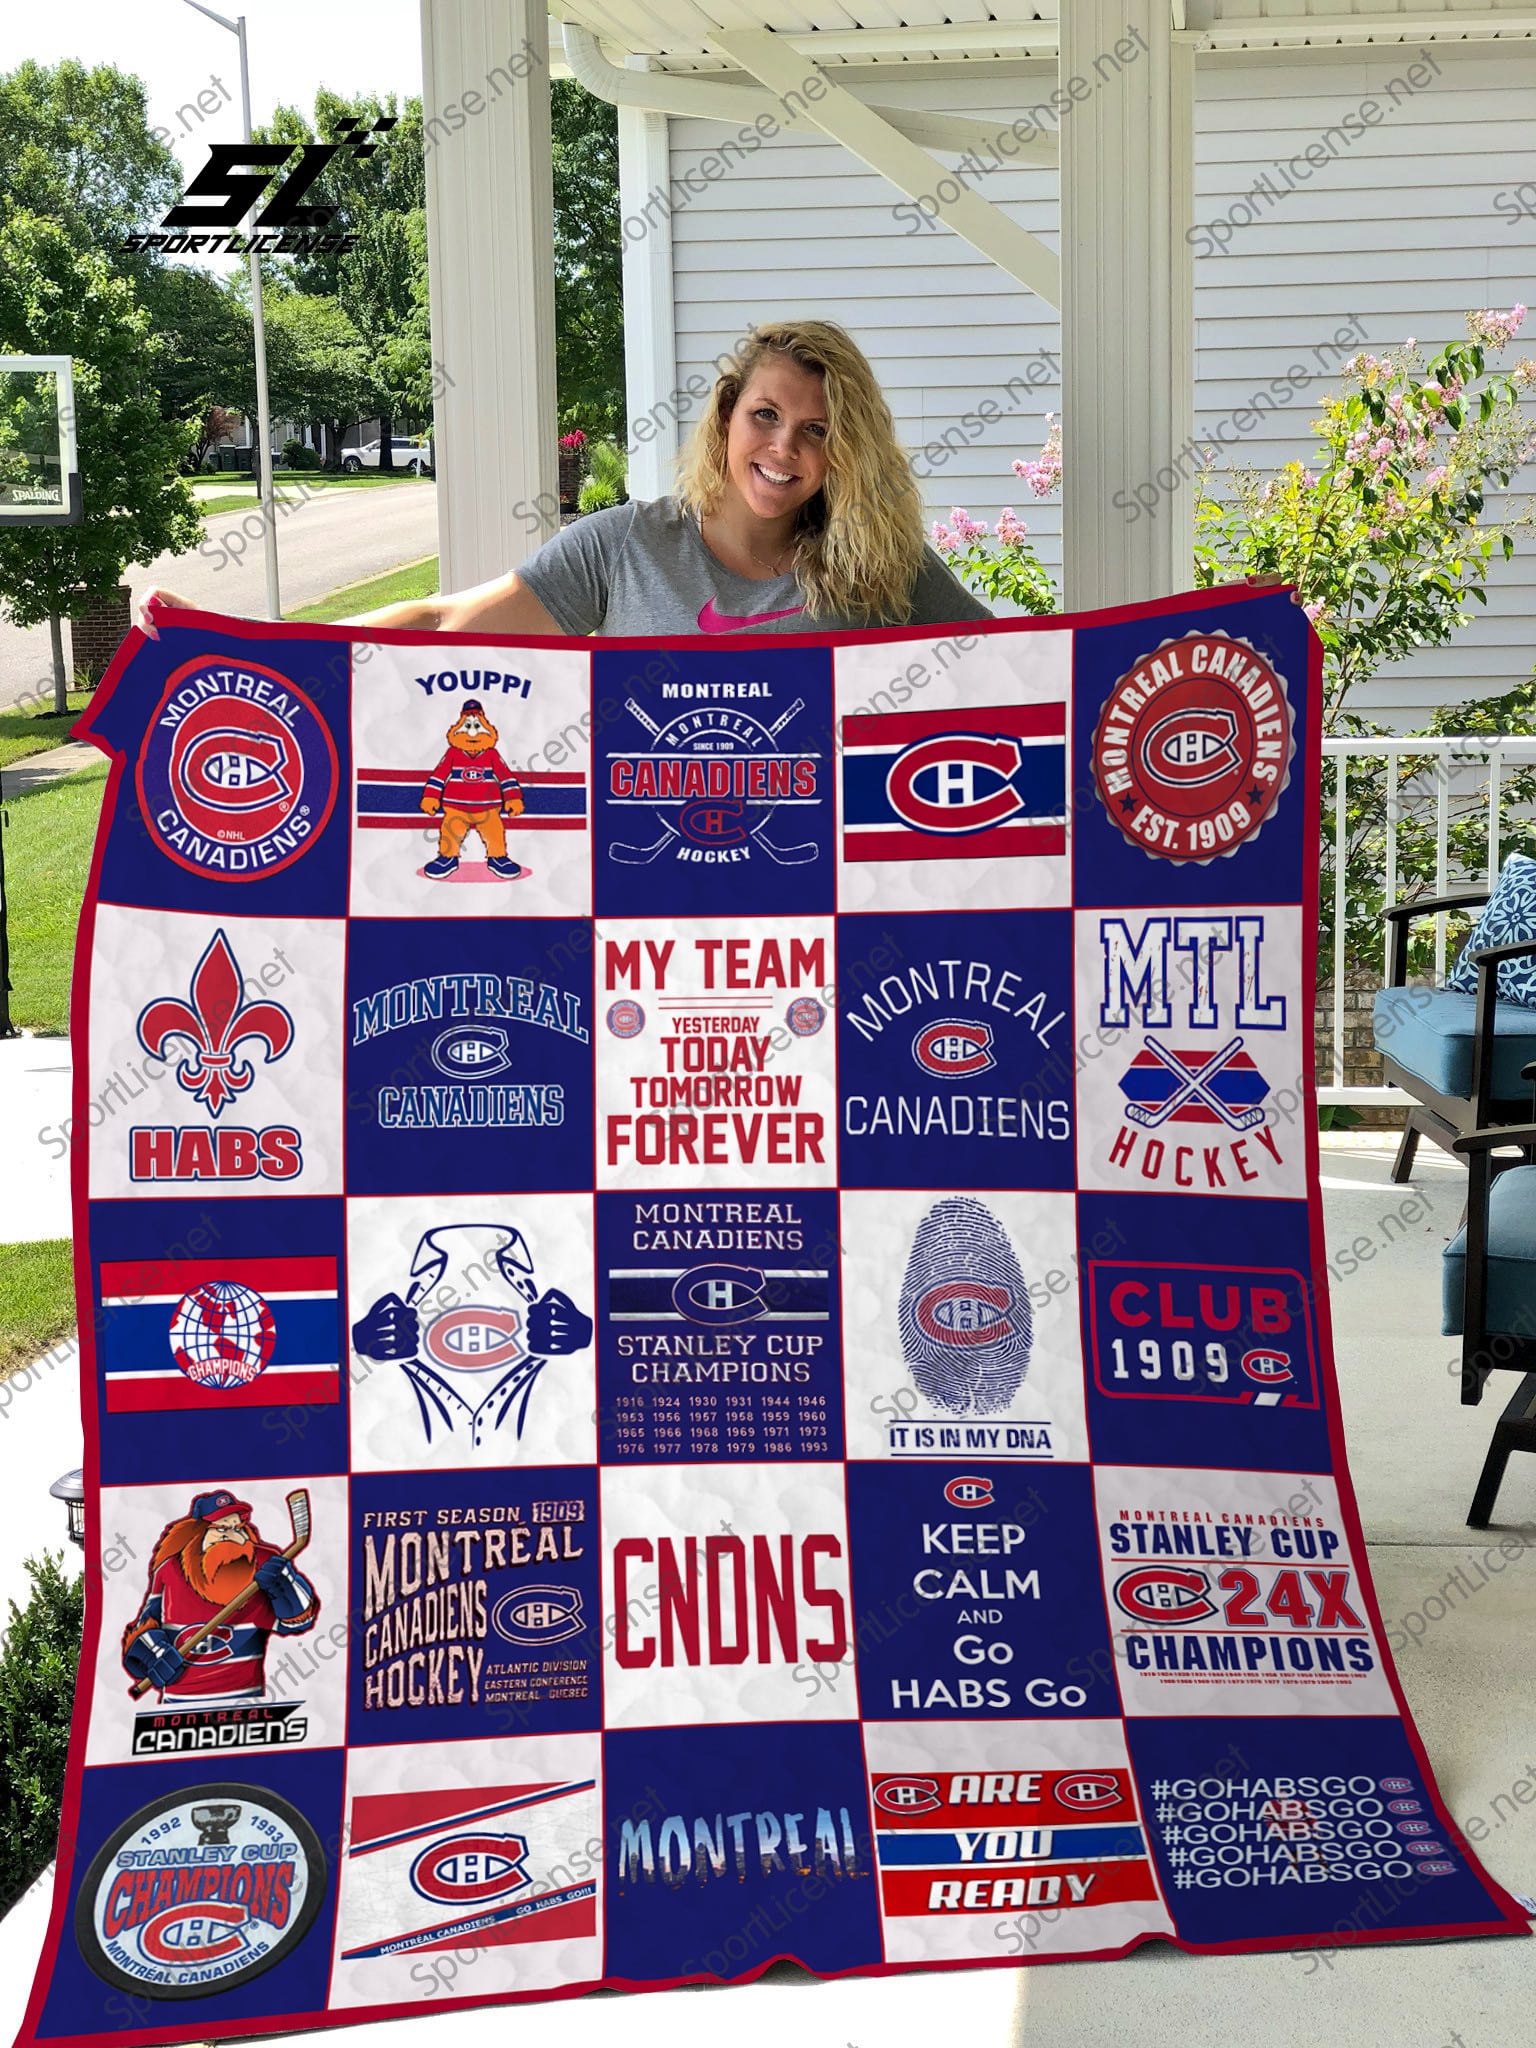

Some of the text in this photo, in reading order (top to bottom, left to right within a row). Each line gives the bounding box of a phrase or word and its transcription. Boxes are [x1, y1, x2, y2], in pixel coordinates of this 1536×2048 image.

[12, 489, 61, 502] SPALDING
[159, 671, 300, 728] MONTREAL
[415, 670, 532, 699] YOUPPI
[662, 682, 772, 698] MONTREAL
[666, 713, 763, 747] MONTREAL
[1102, 644, 1283, 796] MONTREAL CANADIENS
[693, 742, 734, 751] SINCE 1909
[610, 760, 817, 797] CANADIENS
[1130, 801, 1251, 851] EST. 1909
[676, 847, 750, 863] HOCKEY
[605, 938, 825, 990] MY TEAM
[1100, 915, 1286, 1031] MTL
[353, 973, 589, 1047] MONTREAL
[846, 960, 1066, 1050] MONTREAL
[672, 1016, 760, 1033] YESTERDAY
[660, 1036, 771, 1073] TODAY
[378, 1084, 564, 1129] CANADIENS
[630, 1075, 802, 1108] TOMORROW
[846, 1096, 1070, 1140] CANADIENS
[129, 1125, 303, 1182] HABS
[607, 1113, 825, 1166] FOREVER
[1108, 1125, 1283, 1188] HOCKEY
[635, 1203, 802, 1224] MONTREAL
[633, 1230, 803, 1251] CANADIENS
[1110, 1280, 1291, 1334] CLUB
[618, 1335, 823, 1356] STANLEY CUP
[1112, 1338, 1229, 1383] 1909
[188, 1358, 258, 1383] CHAMPIONS
[632, 1362, 811, 1383] CHAMPIONS
[616, 1396, 826, 1408] 1916 1924 1930 1931 1944 1946
[653, 1411, 680, 1422] 1956
[762, 1411, 790, 1421] 1959
[798, 1411, 826, 1421] 1960
[617, 1426, 827, 1438] 1965 1966 1968 1969 1971 1973
[889, 1428, 1052, 1449] IT IS IN MY DNA
[617, 1442, 828, 1454] 1976 1977 1978 1979 1986 1993
[363, 1501, 583, 1529] FIRST SEASON 1909
[1119, 1510, 1325, 1528] MONTREAL CANADIENS
[922, 1523, 1026, 1554] KEEP
[1109, 1523, 1339, 1560] STANLEY CUP
[913, 1569, 1041, 1600] CALM
[1217, 1568, 1365, 1629] 24X
[613, 1534, 848, 1669] CNDNS
[957, 1609, 1003, 1624] AND
[365, 1579, 488, 1671] CANADIENS
[486, 1660, 587, 1675] ATLANTIC DIVISION
[1126, 1636, 1374, 1672] CHAMPIONS
[365, 1645, 485, 1711] HOCKEY
[484, 1678, 527, 1690] EASTERN
[891, 1679, 1011, 1709] HABS
[153, 1708, 274, 1728] MONTREAL
[136, 1718, 308, 1754] CANADIENS
[949, 1773, 1043, 1804] ARE
[1150, 1776, 1376, 1800] #GOHABSGO
[1156, 1798, 1384, 1823] #GOHABSGO
[140, 1815, 284, 1846] 1992 1993
[954, 1830, 1053, 1861] YOU
[1161, 1819, 1393, 1845] #GOHABSGO
[116, 1842, 298, 1868] STANLEY CUP
[619, 1807, 866, 1888] MONTREAL
[1167, 1840, 1402, 1867] #GOHABSGO
[1173, 1861, 1413, 1889] #GOHABSGO
[103, 1861, 296, 1940] CHAMPIONS
[928, 1873, 1096, 1909] READY
[436, 1915, 496, 1939] CANADIENS
[516, 1903, 532, 1916] GO
[535, 1895, 563, 1909] HABS
[566, 1887, 592, 1901] GO!!!
[177, 1941, 270, 1984] CANADIENS
